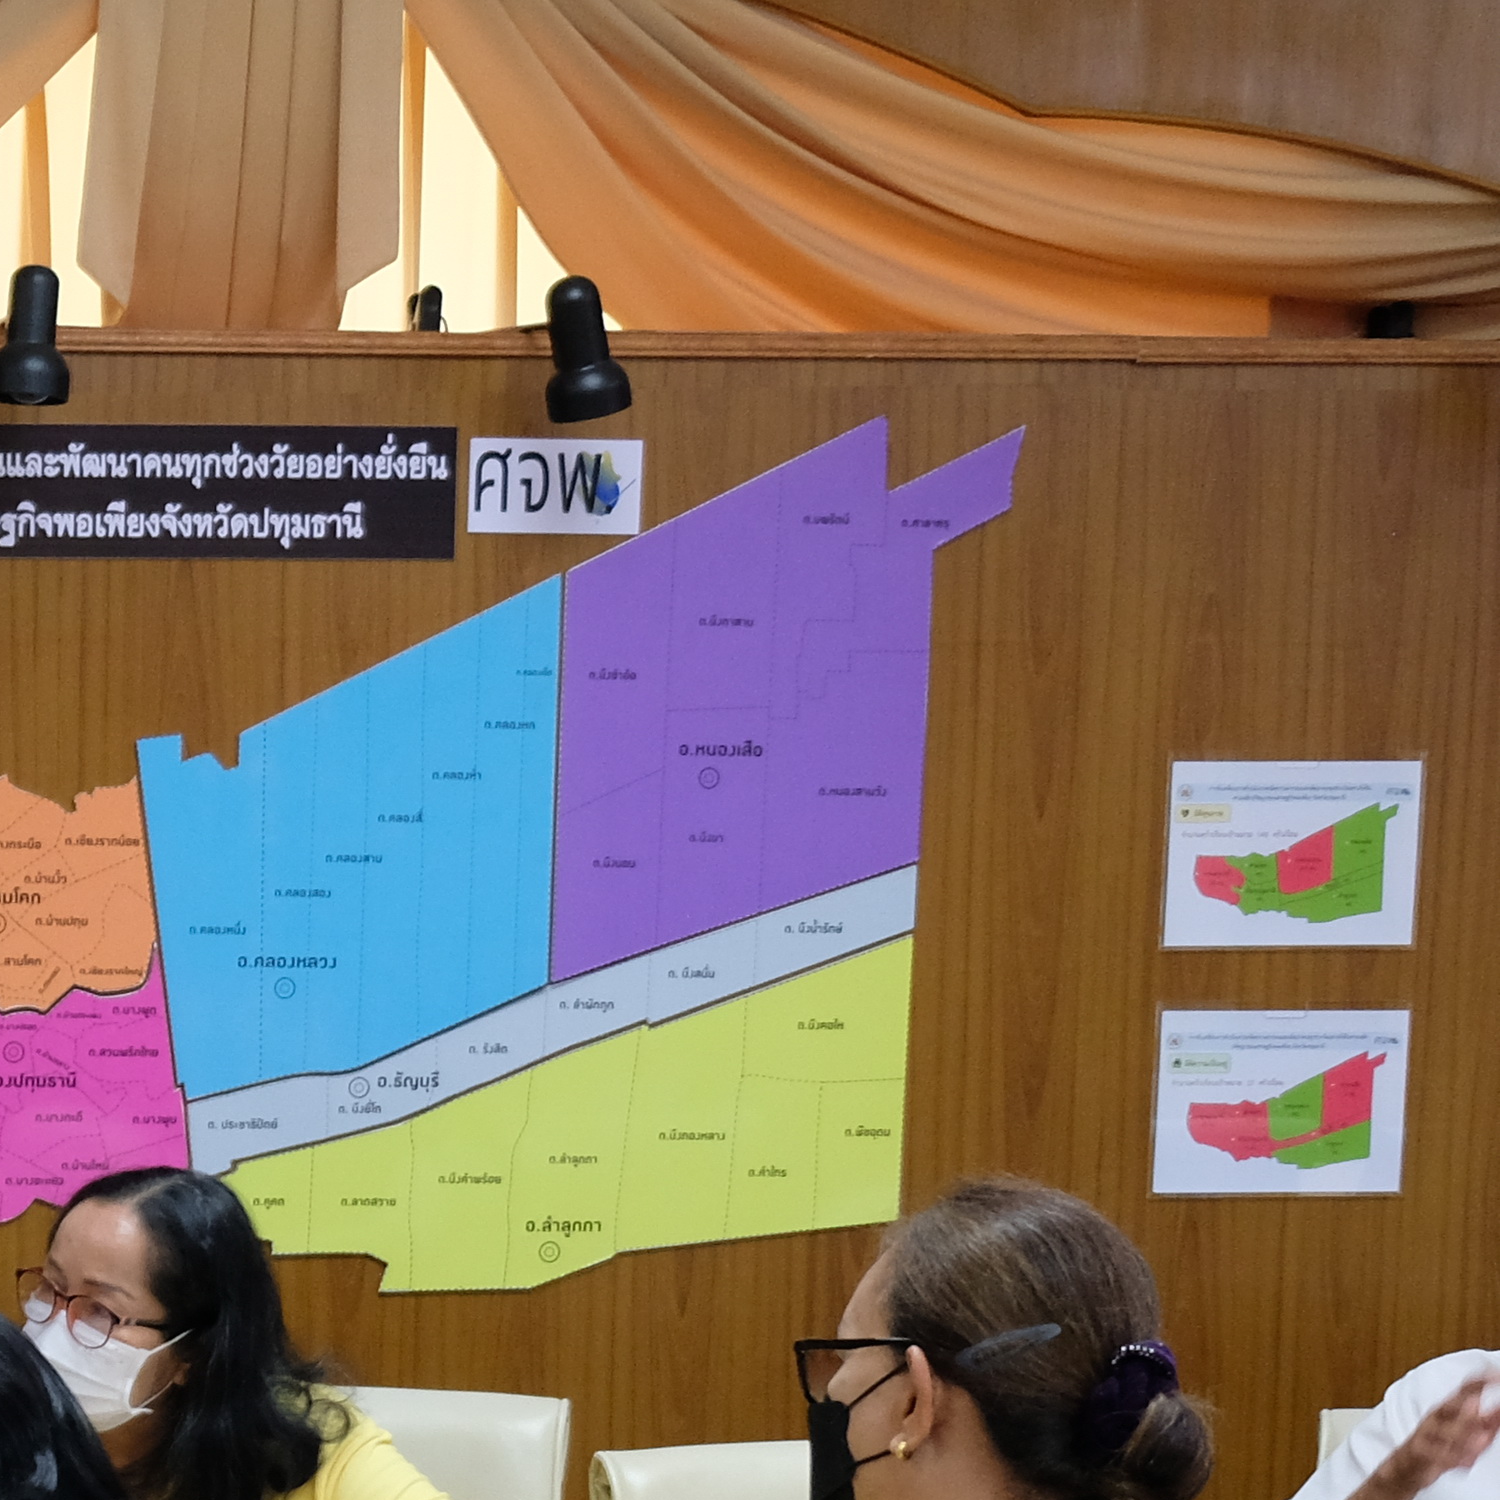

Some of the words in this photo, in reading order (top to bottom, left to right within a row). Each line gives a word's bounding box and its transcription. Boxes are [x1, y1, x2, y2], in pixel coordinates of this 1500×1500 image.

[237, 955, 337, 969] อ.คลองหลวง
[377, 1070, 440, 1092] อ.ธัญบุรี
[525, 1214, 602, 1237] อ.ลำลูกกา
